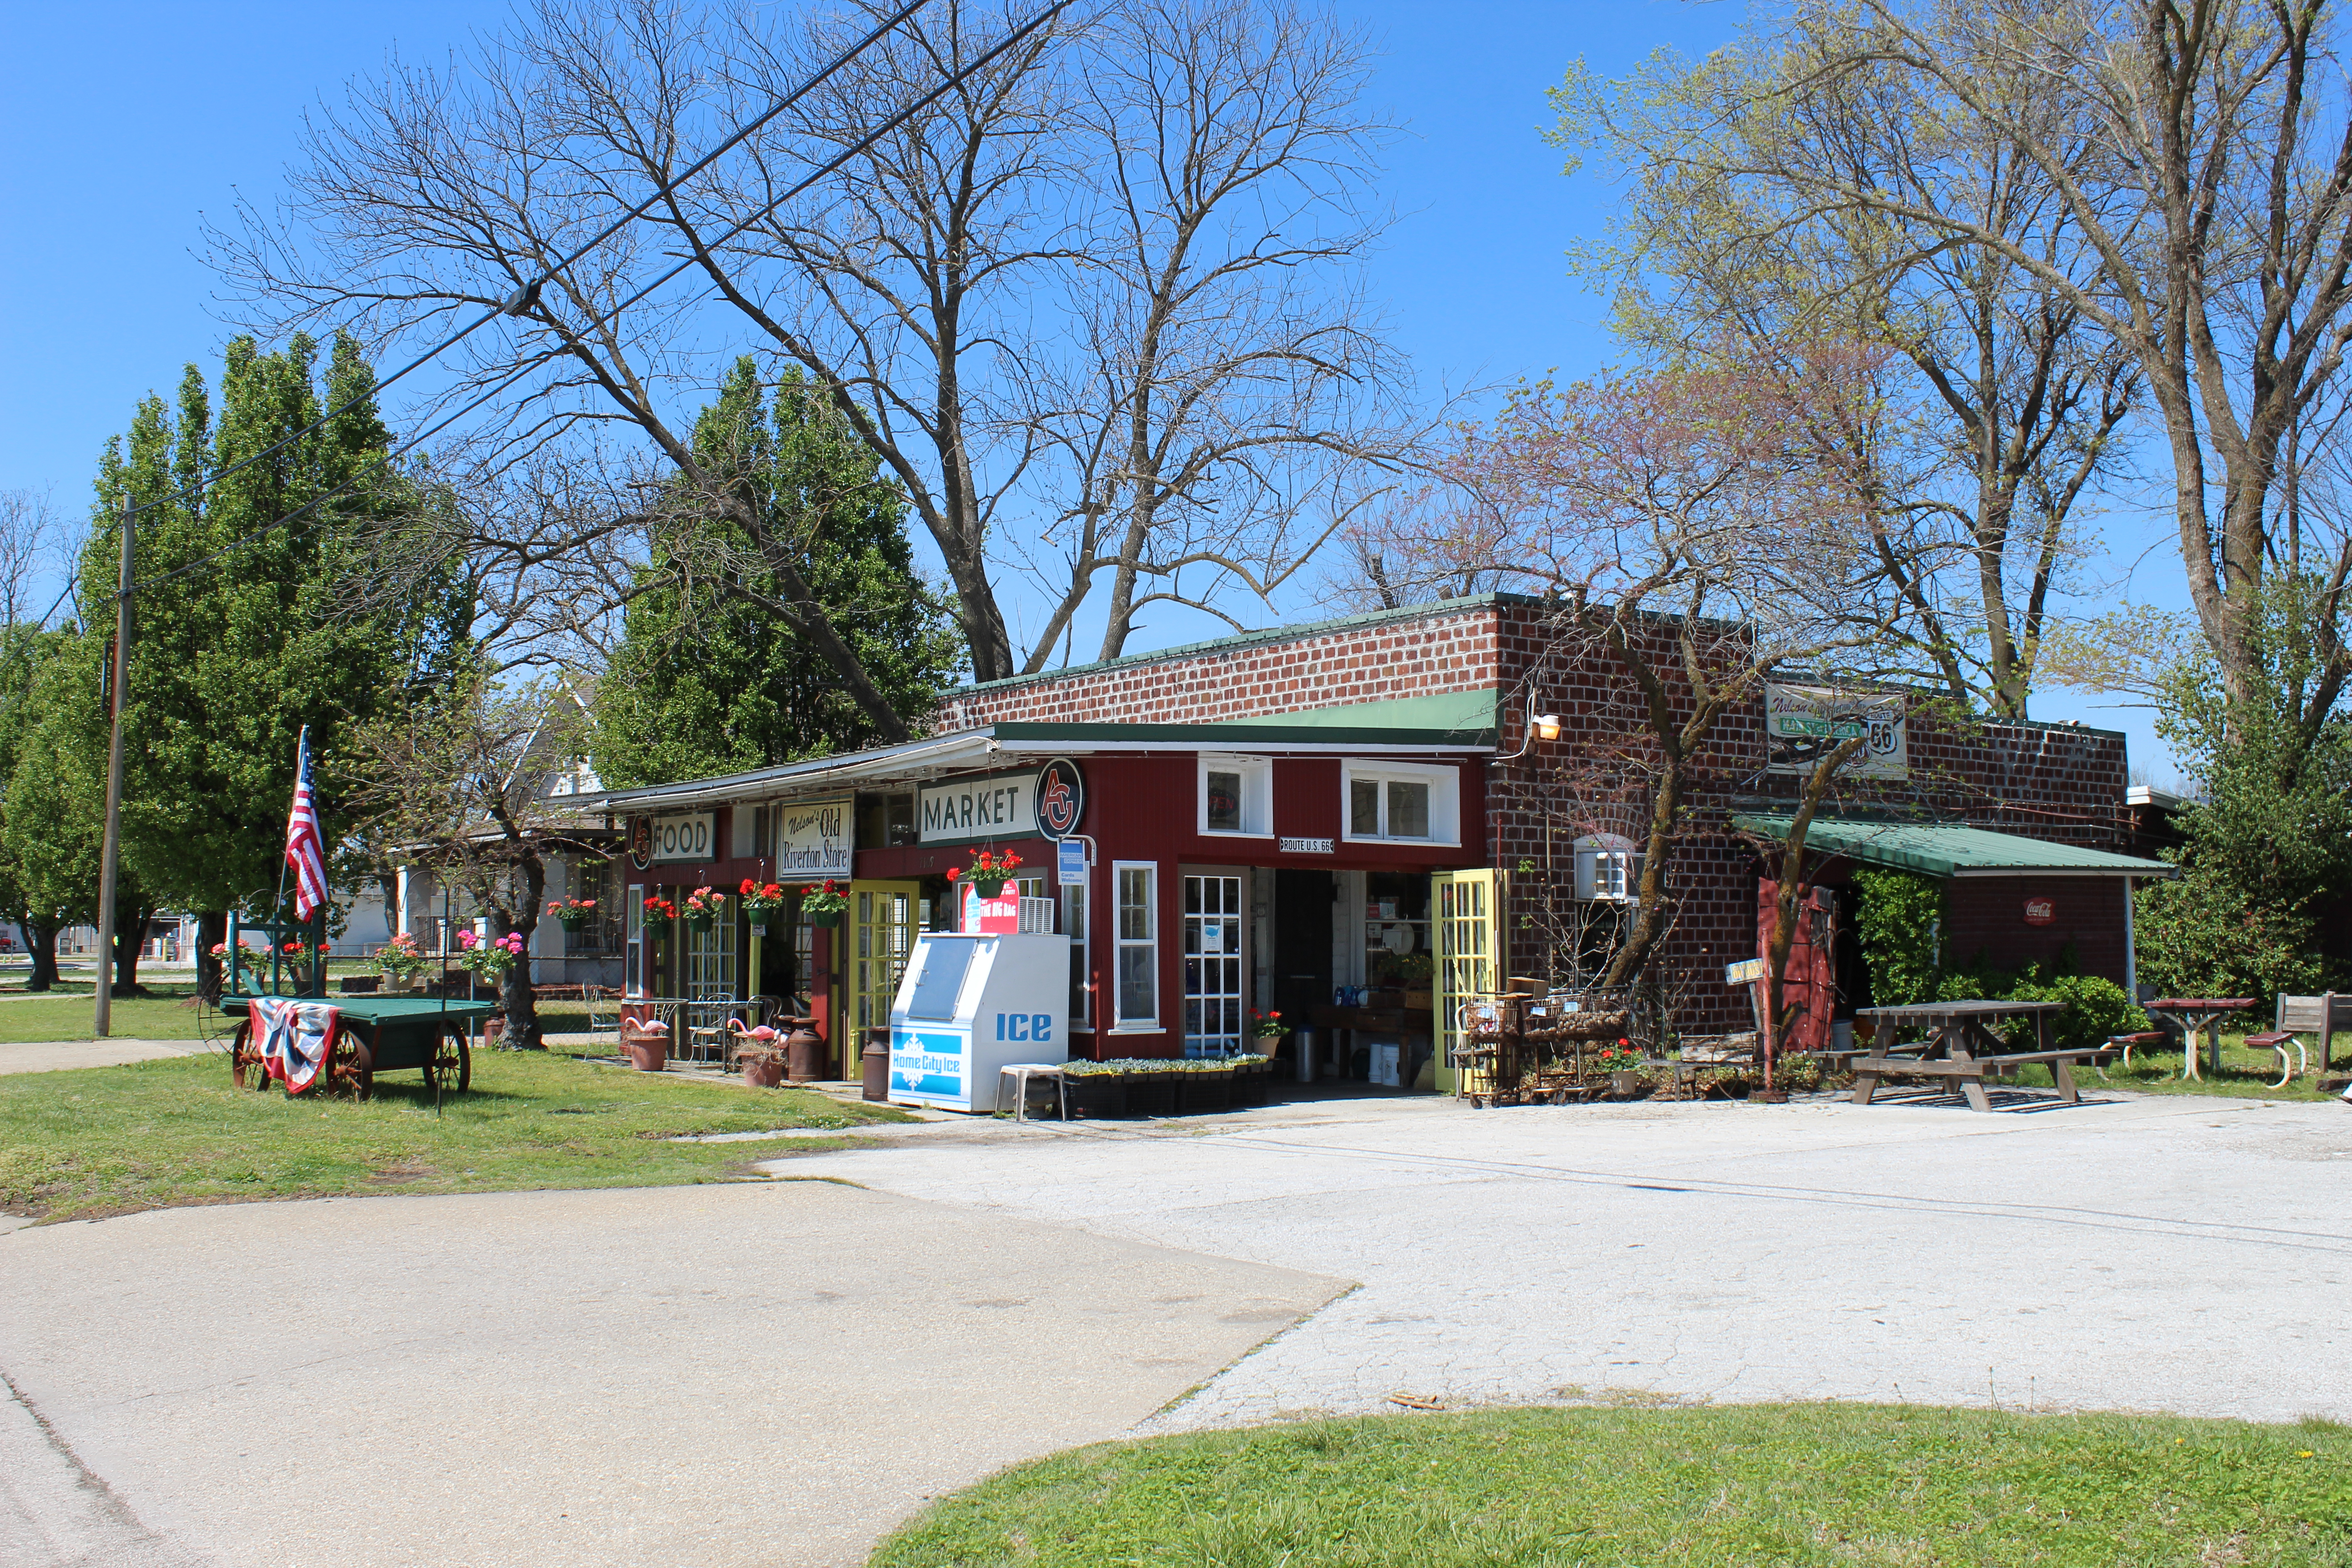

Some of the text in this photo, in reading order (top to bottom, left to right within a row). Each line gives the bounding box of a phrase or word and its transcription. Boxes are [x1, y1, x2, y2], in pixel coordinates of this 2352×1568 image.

[1871, 723, 1891, 748] 66
[925, 786, 1019, 831] MARKET
[1209, 796, 1234, 809] PEN
[789, 810, 819, 835] Nelson's
[820, 808, 840, 837] Old
[653, 821, 707, 854] FOOD
[1284, 840, 1329, 851] ROUTE U.S. 66
[784, 839, 847, 869] Riverton Store
[981, 903, 991, 917] THE
[992, 902, 1002, 917] BIG
[1003, 902, 1016, 917] BAG
[2027, 902, 2051, 917] Coca-Cola
[1733, 970, 1744, 979] OR
[893, 1053, 960, 1073] Home City Ice
